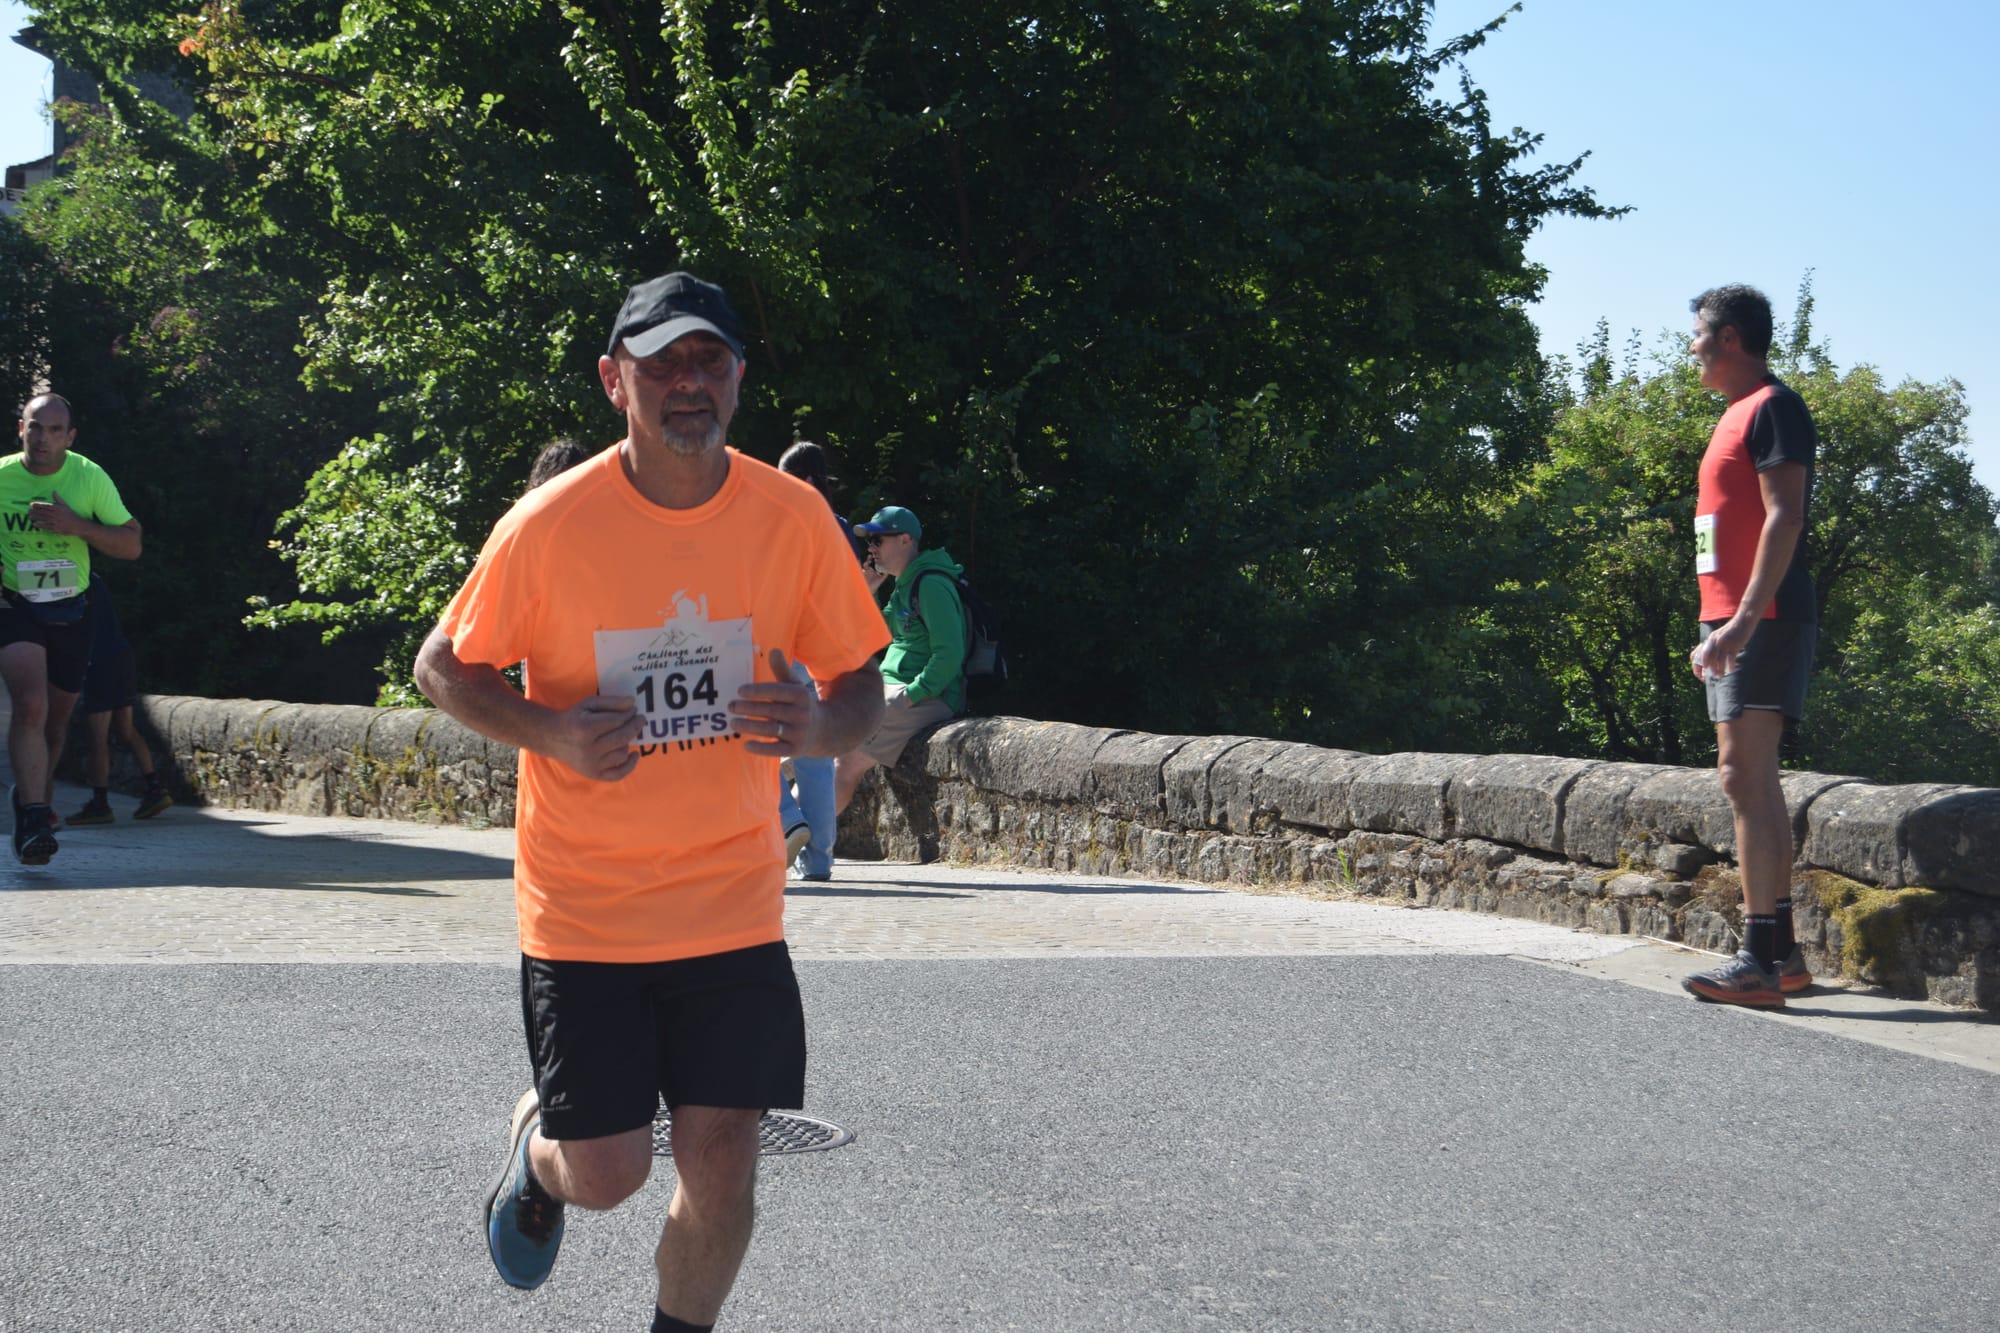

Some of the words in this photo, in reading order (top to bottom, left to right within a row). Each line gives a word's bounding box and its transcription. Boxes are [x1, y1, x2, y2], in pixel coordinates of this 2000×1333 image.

[34, 570, 60, 588] 71
[639, 649, 689, 660] Challenge
[695, 645, 713, 655] des
[636, 669, 718, 713] 164
